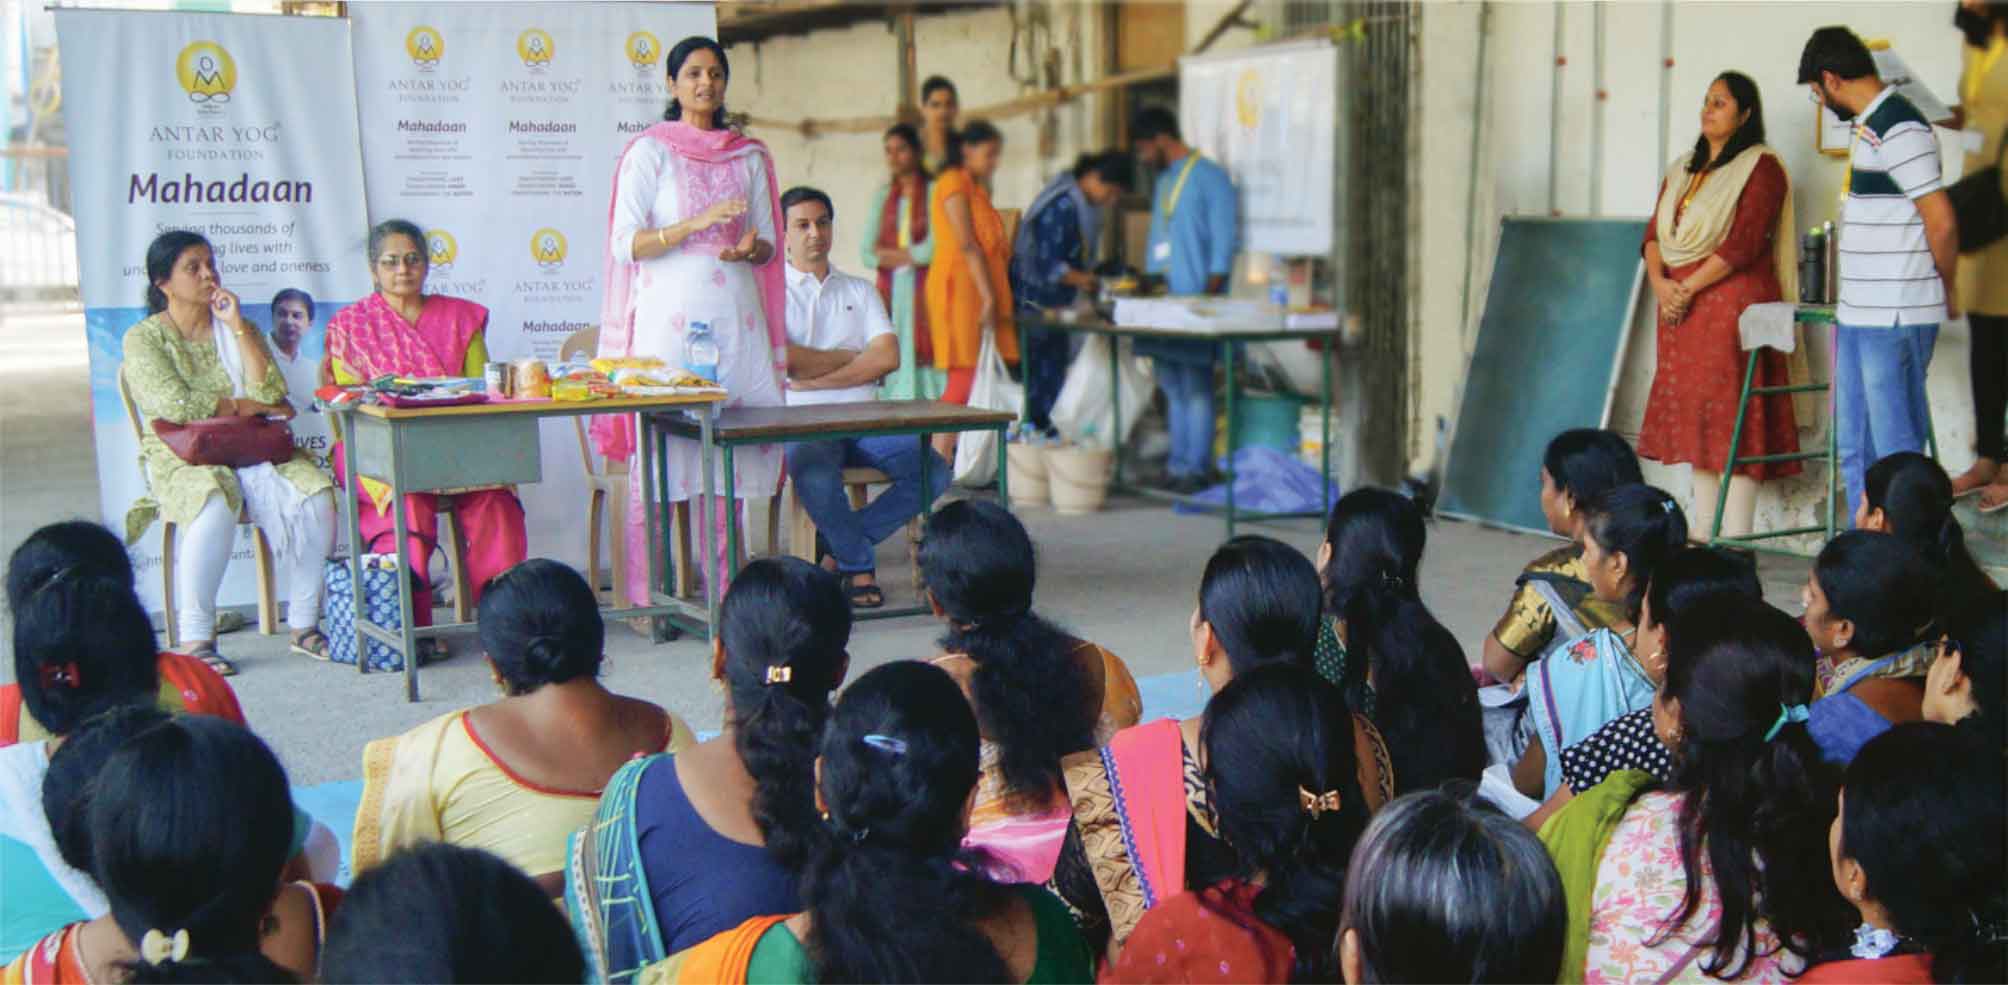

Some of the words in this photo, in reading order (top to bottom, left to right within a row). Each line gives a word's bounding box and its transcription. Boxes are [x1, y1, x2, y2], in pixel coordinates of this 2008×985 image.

[389, 79, 434, 92] ANTAR
[500, 79, 547, 93] ANTAR
[397, 119, 467, 133] Mahadaan
[508, 120, 577, 133] Mahadaan
[150, 125, 225, 143] ANTAR
[167, 148, 265, 161] FOUNDATION
[128, 172, 313, 204] Mahadaan
[209, 222, 278, 236] thousands
[281, 221, 296, 237] of
[229, 242, 259, 255] lives
[263, 242, 293, 255] with
[221, 261, 249, 274] love
[251, 260, 278, 274] and
[280, 261, 331, 273] oneness
[514, 280, 561, 293] ANTAR
